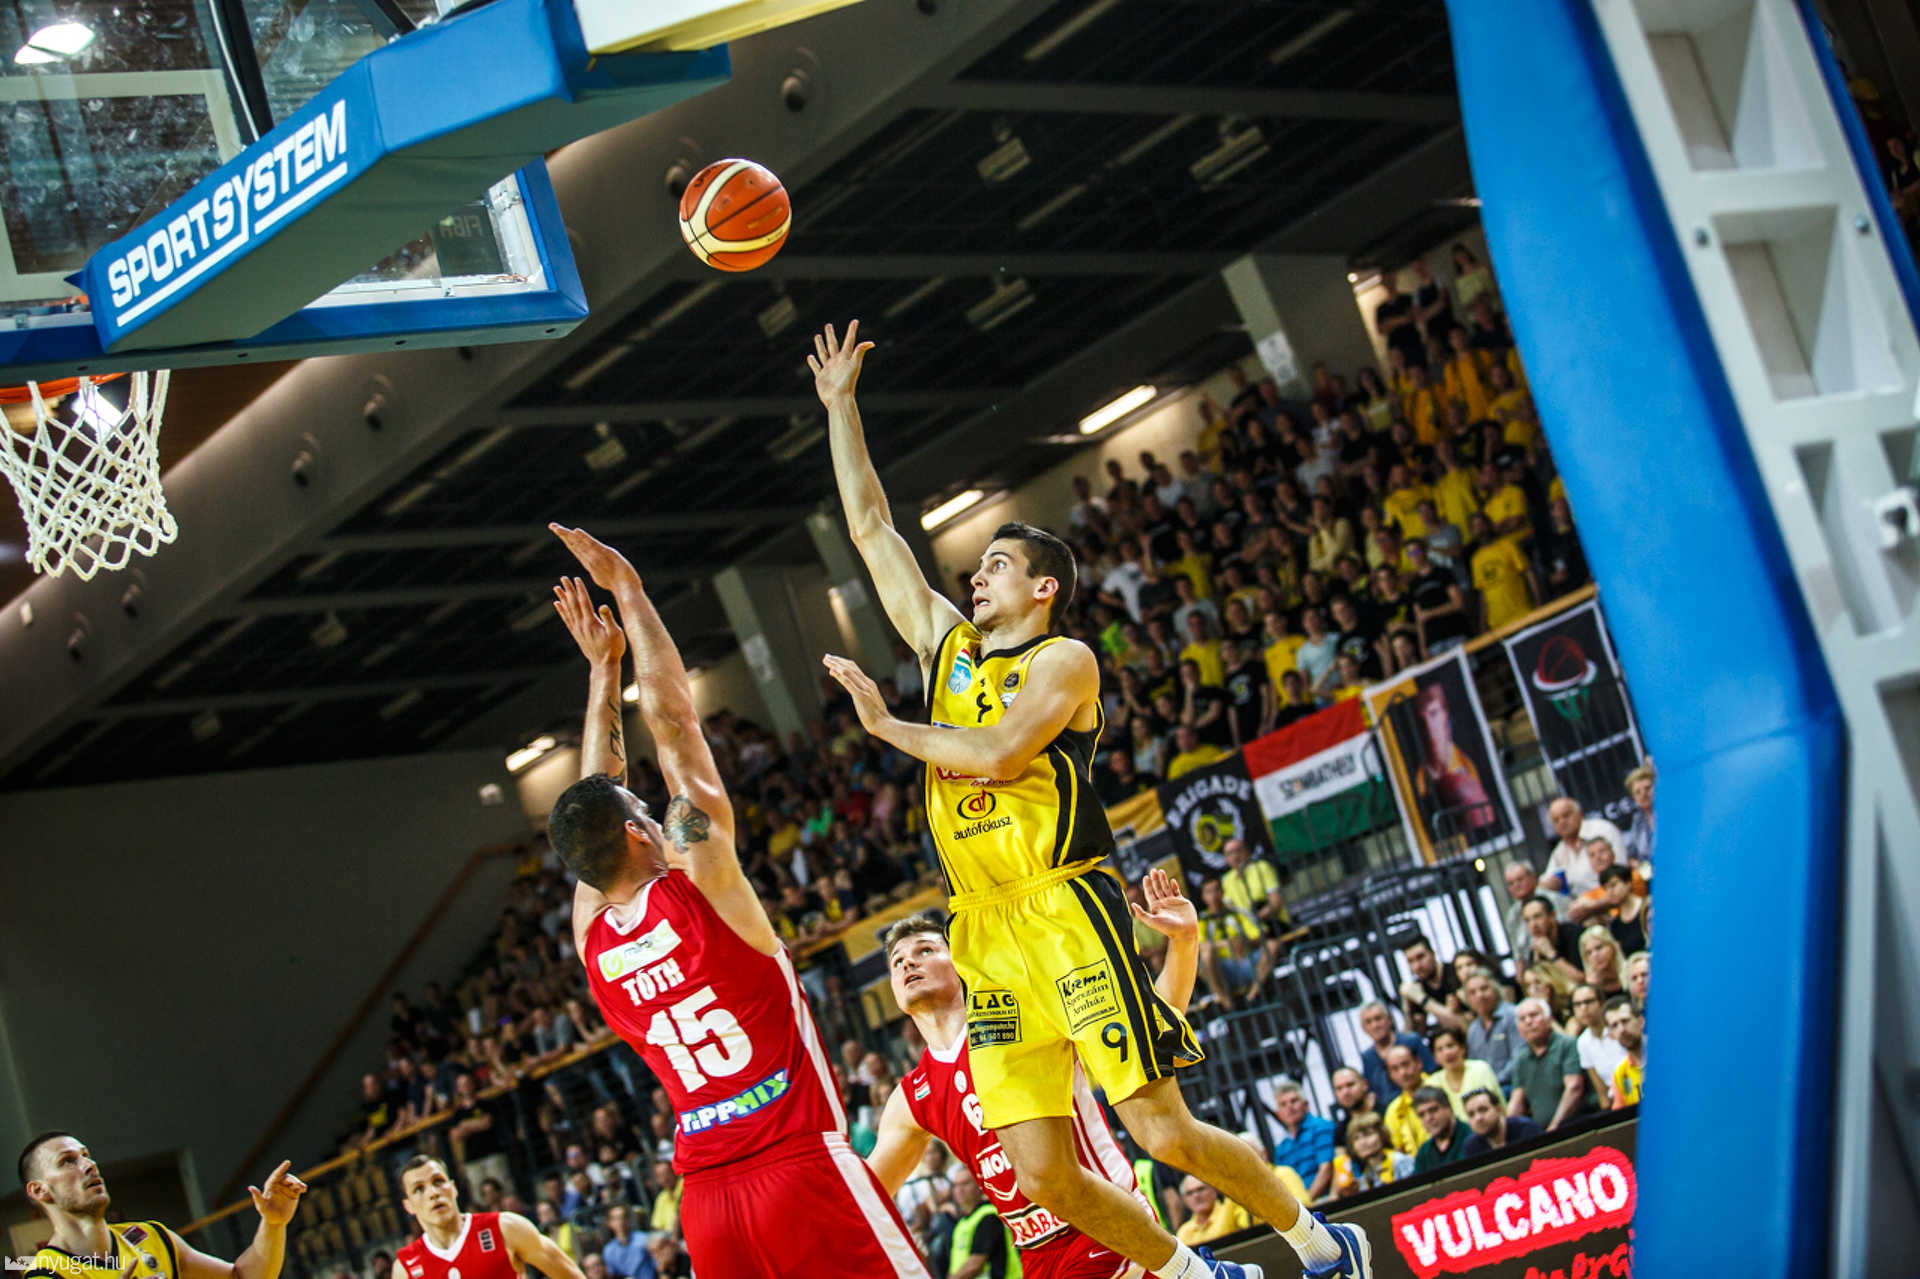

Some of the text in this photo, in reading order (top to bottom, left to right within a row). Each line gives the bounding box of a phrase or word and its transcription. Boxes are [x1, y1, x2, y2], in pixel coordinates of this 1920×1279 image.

[107, 98, 348, 309] SPORTSYSTEM
[953, 815, 1013, 841] autófókusz
[1165, 773, 1251, 829] BRIGADE
[620, 956, 686, 1007] TÓTH
[645, 985, 753, 1094] 15
[1101, 1021, 1129, 1063] 9
[1401, 1162, 1629, 1268] VULCANO
